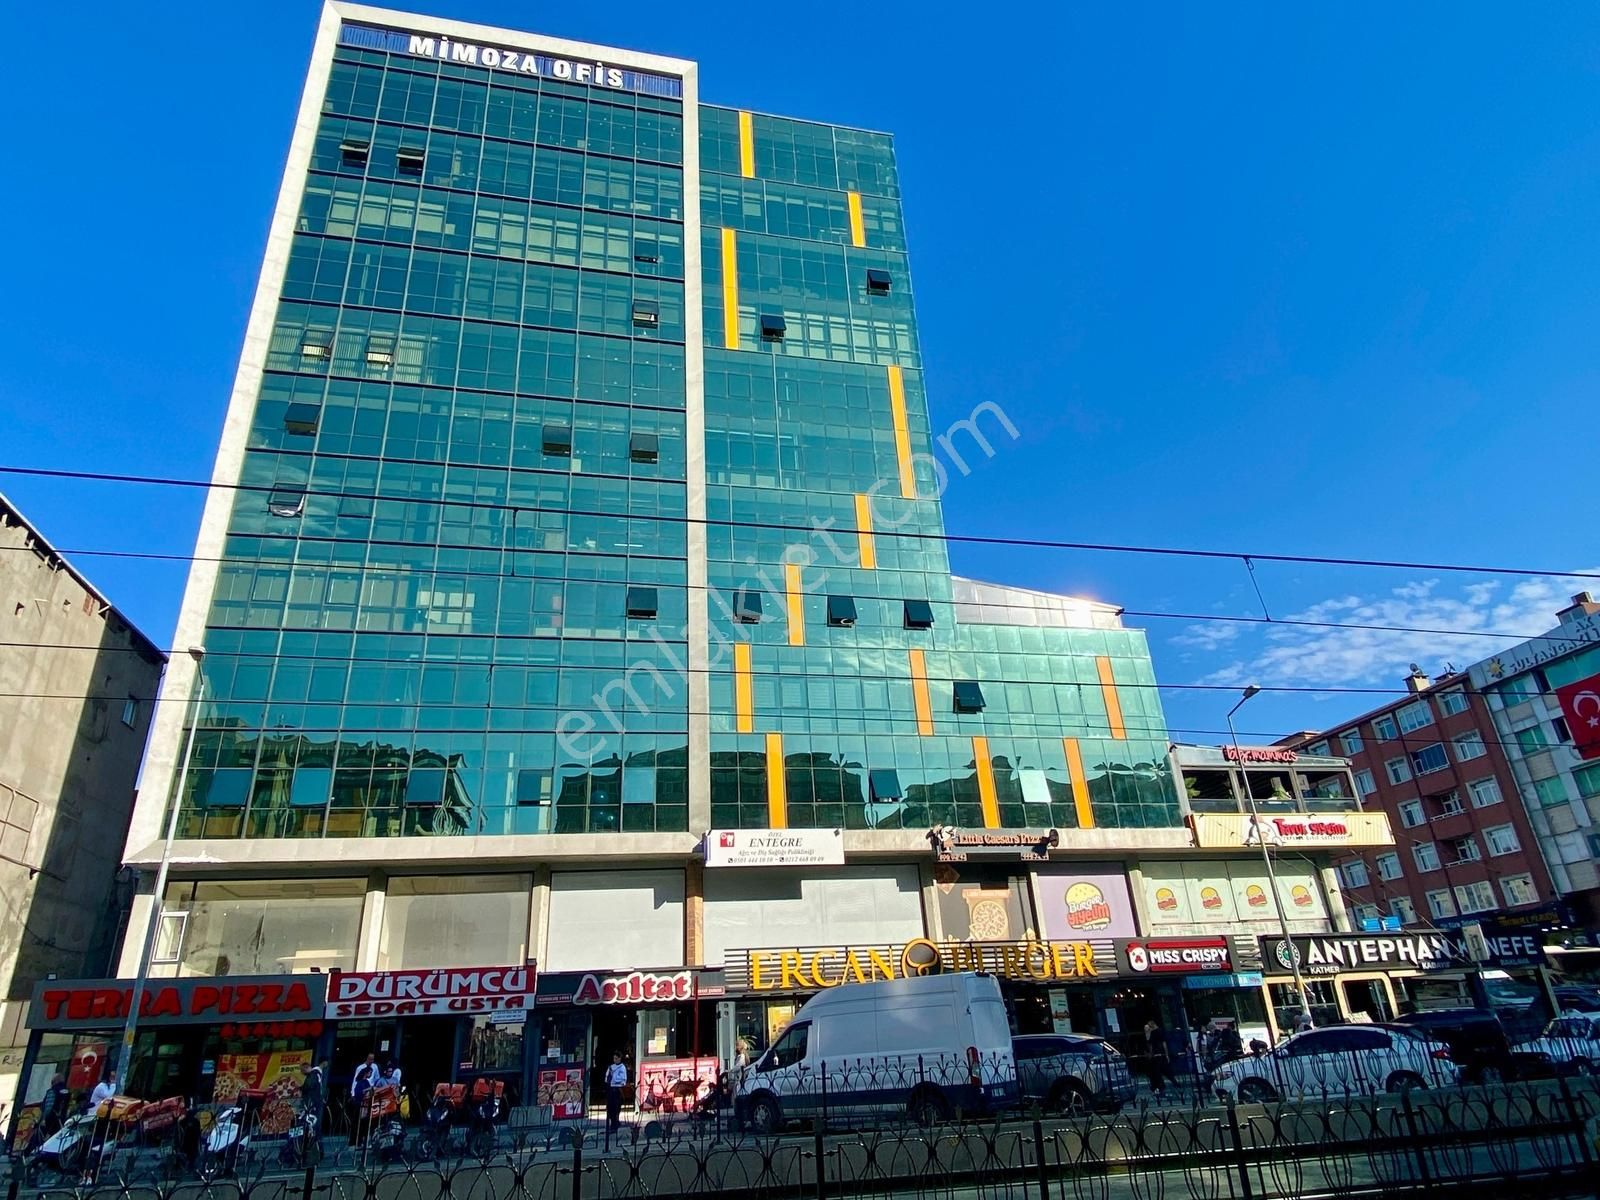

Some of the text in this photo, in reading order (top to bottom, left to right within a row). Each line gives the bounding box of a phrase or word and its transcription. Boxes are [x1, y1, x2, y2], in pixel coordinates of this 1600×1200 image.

[408, 36, 624, 88] MİMOZA OFİS
[749, 838, 803, 848] ENTEGRE
[750, 941, 1098, 990] ERCAN BURGER
[1150, 948, 1228, 963] MISS CRISPY
[1308, 937, 1451, 967] ANTEPHAN
[1460, 936, 1537, 957] KNEFE
[339, 966, 527, 999] DÜRÜMCÜ
[575, 971, 692, 1004] Asıltat
[43, 987, 182, 1021] TERRA
[336, 995, 526, 1017] SEDAT USTA
